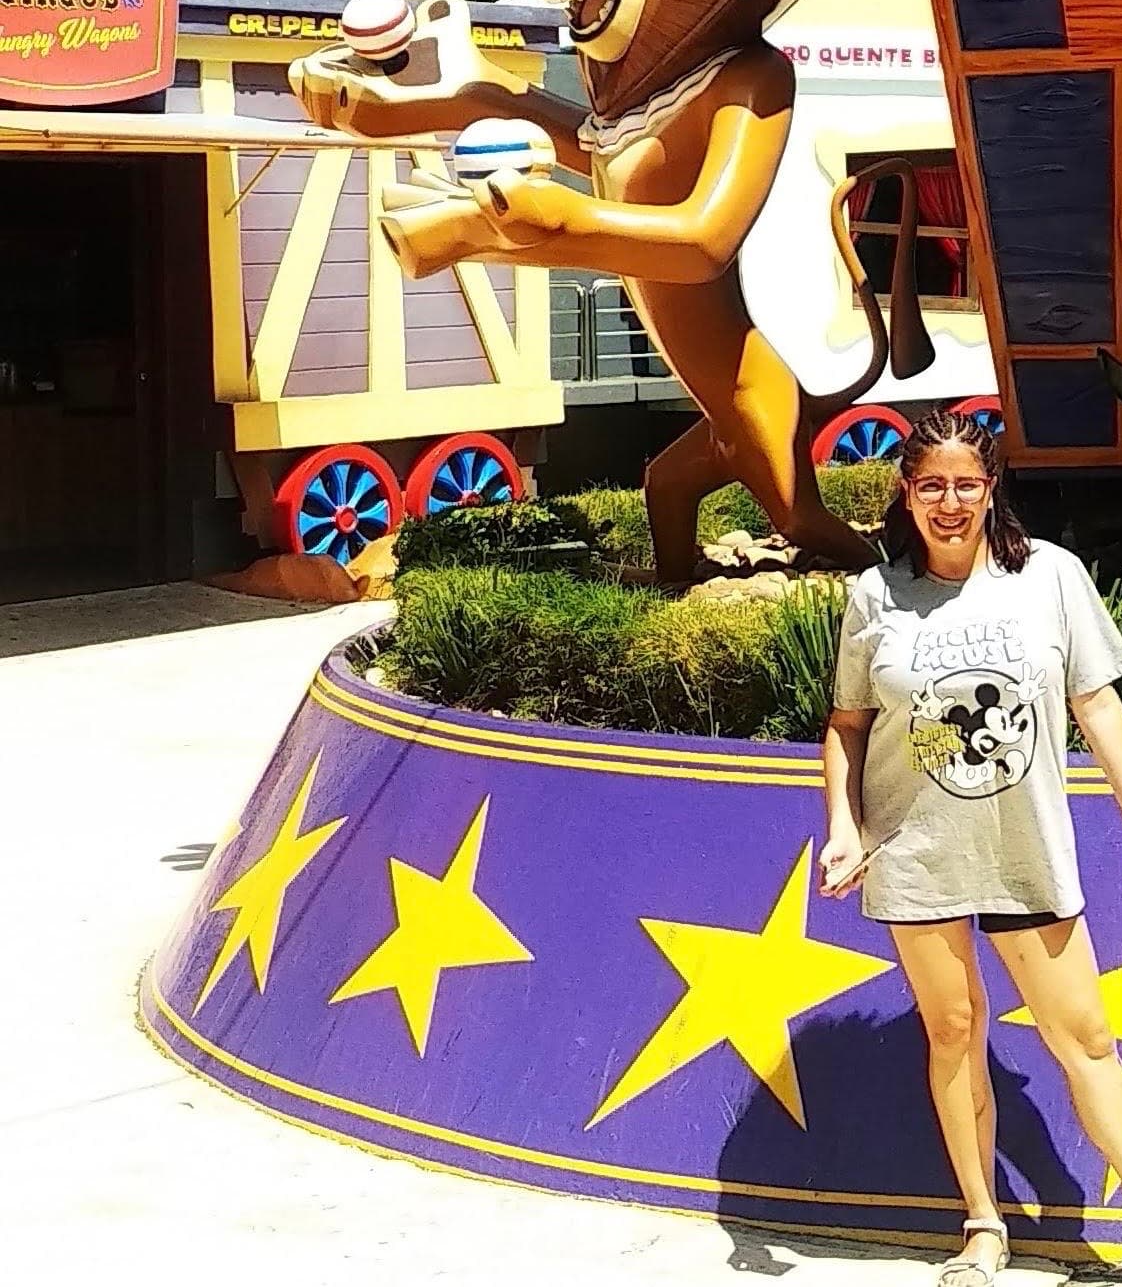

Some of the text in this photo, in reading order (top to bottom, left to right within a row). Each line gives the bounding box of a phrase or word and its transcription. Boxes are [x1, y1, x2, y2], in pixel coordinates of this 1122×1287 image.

[0, 16, 141, 59] ungry Wagons
[471, 25, 527, 47] BIDA
[782, 45, 936, 67] RO QUENTE B
[912, 618, 1019, 651] MICKEY
[911, 639, 1025, 672] MOUSE
